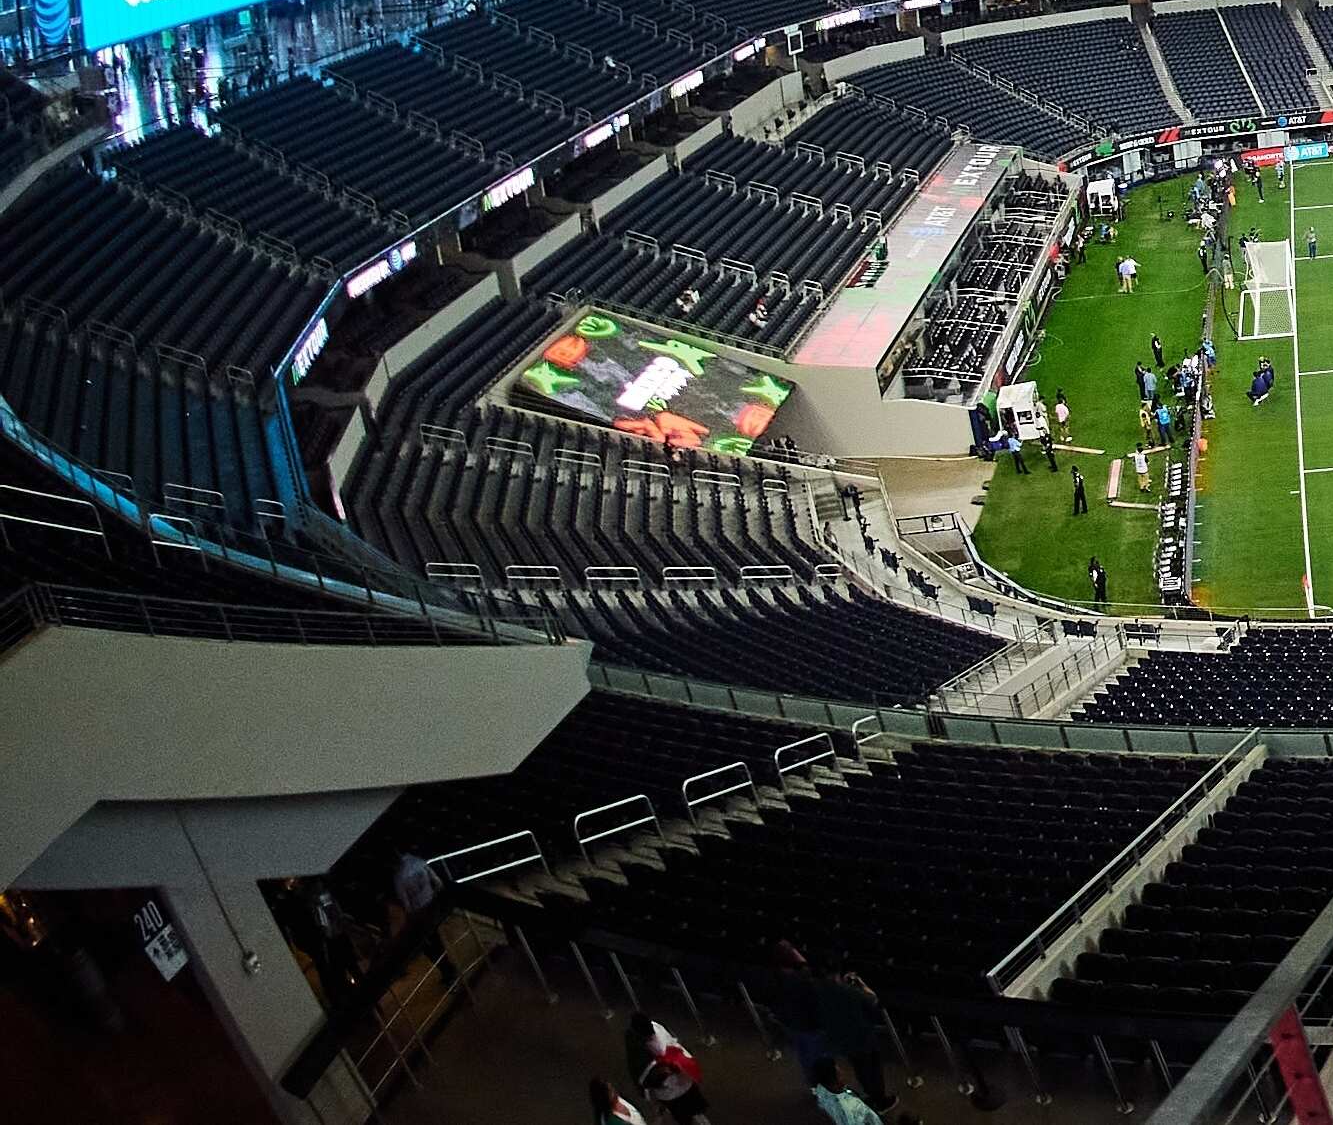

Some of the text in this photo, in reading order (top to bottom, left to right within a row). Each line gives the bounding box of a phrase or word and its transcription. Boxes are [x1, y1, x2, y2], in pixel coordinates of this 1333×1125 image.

[1288, 115, 1307, 125] AT&T
[1301, 144, 1324, 158] AT&T
[134, 900, 164, 941] 240
